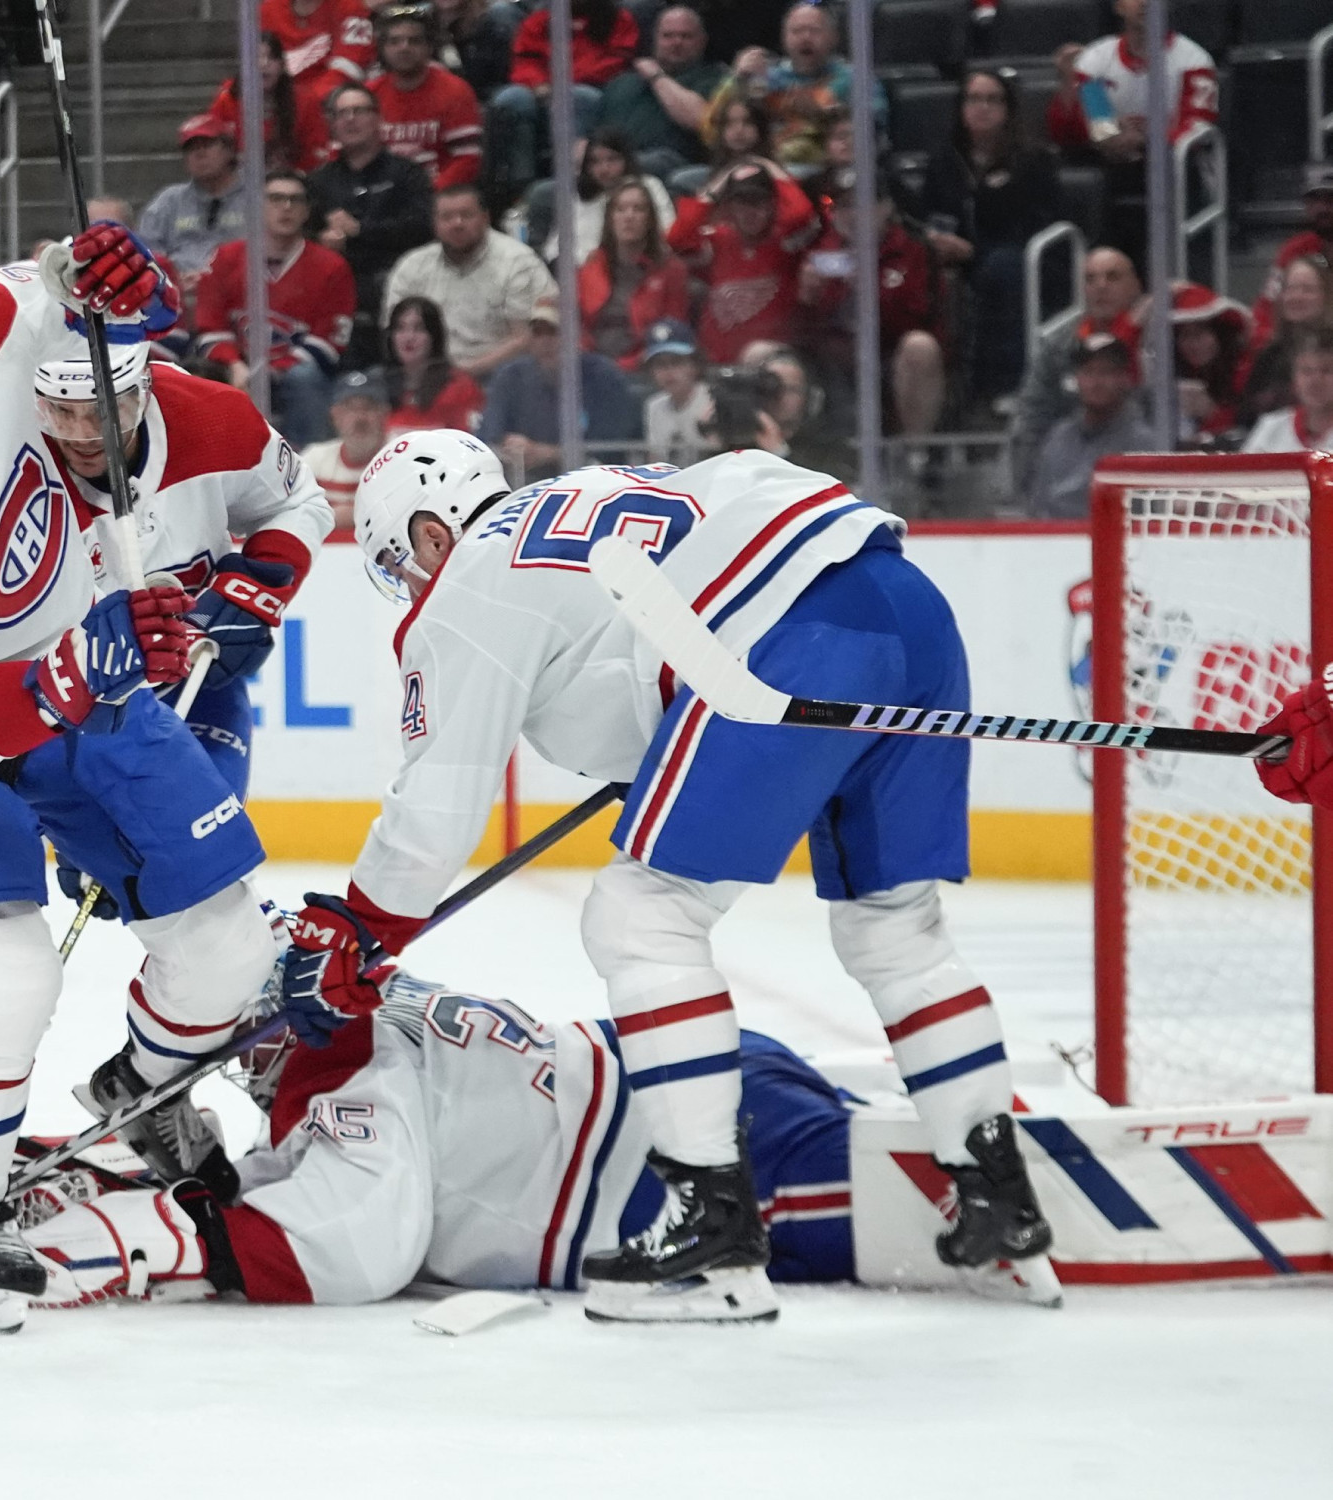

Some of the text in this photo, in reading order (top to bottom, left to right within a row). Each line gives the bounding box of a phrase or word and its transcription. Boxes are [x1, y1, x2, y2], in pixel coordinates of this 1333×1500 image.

[39, 691, 64, 720] DVORAK
[850, 704, 1155, 749] WARRIOR
[1125, 1116, 1311, 1143] TRUE
